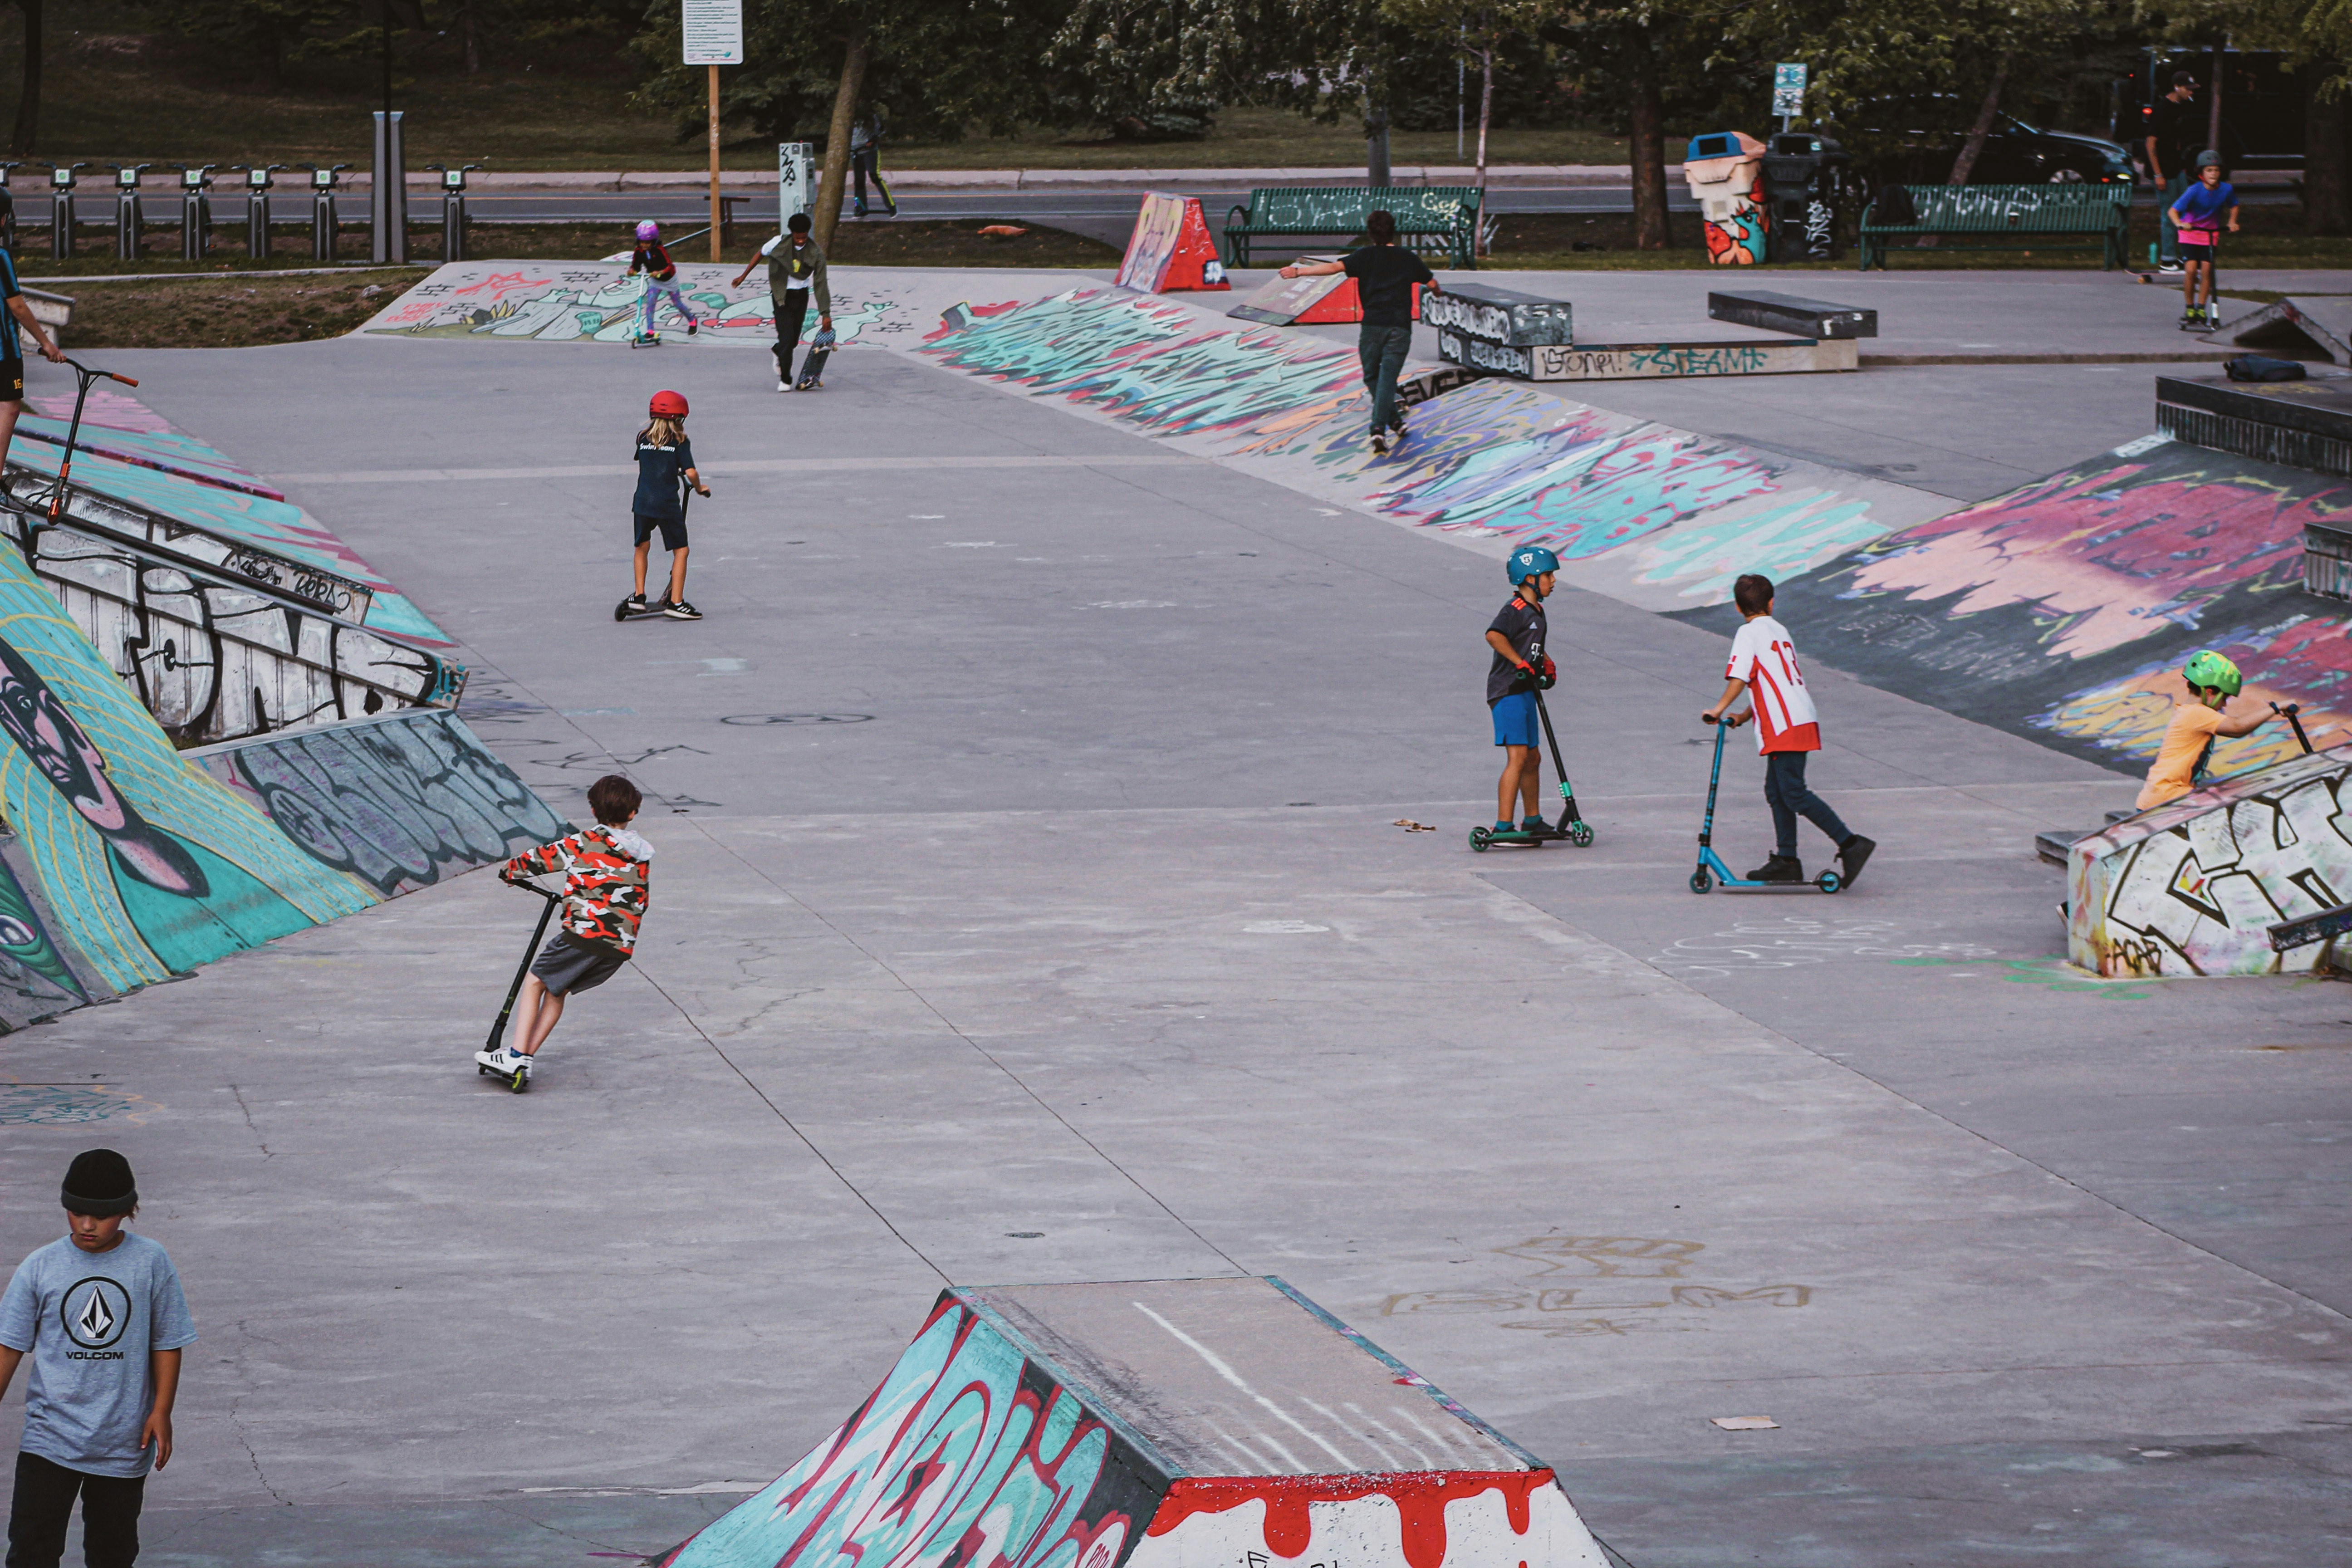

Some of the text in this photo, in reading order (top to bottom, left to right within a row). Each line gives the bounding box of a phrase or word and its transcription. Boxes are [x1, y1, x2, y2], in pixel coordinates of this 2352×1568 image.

[14, 378, 22, 389] 16
[1771, 640, 1803, 686] 13
[1381, 1284, 1812, 1317] BLM
[66, 1351, 124, 1360] VOLCOM
